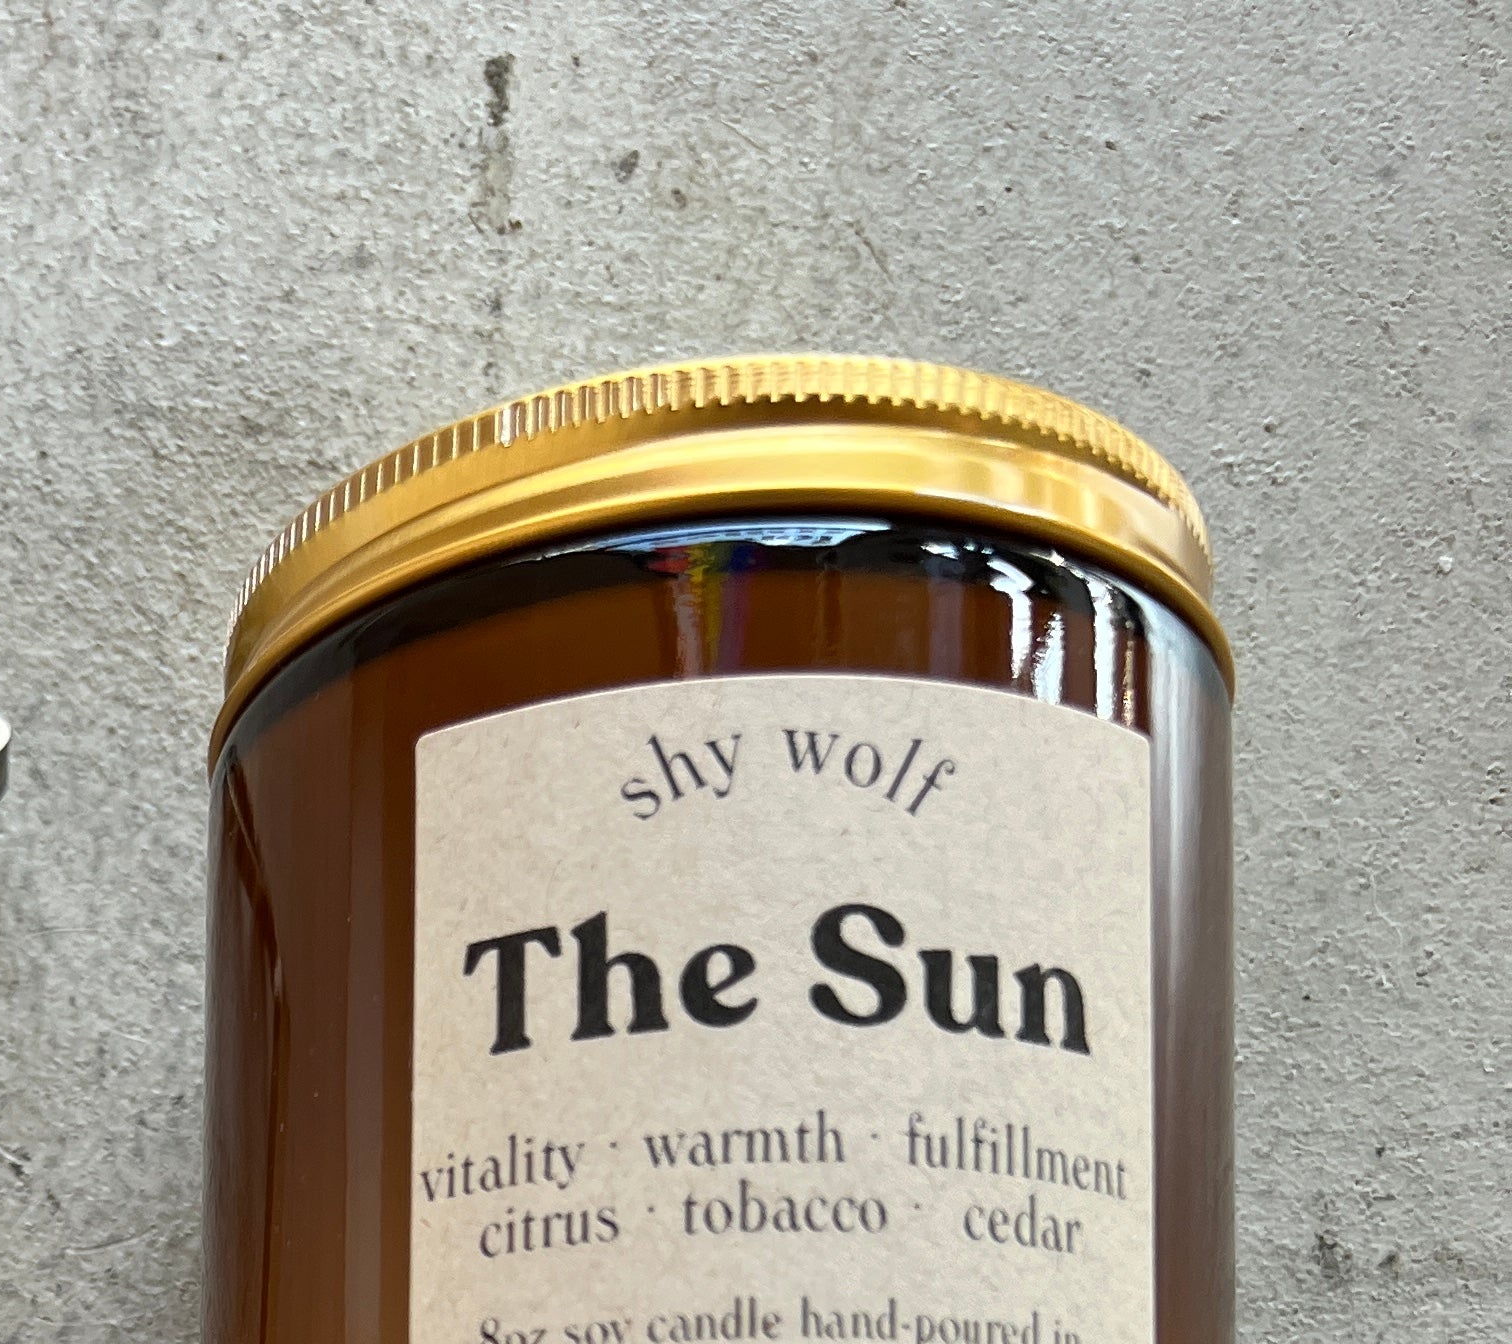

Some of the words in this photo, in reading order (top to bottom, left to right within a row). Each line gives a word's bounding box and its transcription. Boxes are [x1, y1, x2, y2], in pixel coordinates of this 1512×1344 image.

[620, 733, 743, 820] shy
[781, 728, 956, 817] wolf
[464, 910, 757, 1055] The
[808, 904, 1089, 1054] Sun
[421, 1133, 585, 1201] vitality
[643, 1109, 846, 1168] warmth
[905, 1111, 1127, 1202] fulfillment
[479, 1207, 620, 1258] citrus
[683, 1178, 888, 1235] tobacco
[963, 1193, 1082, 1254] cedar
[647, 1296, 782, 1344] candle
